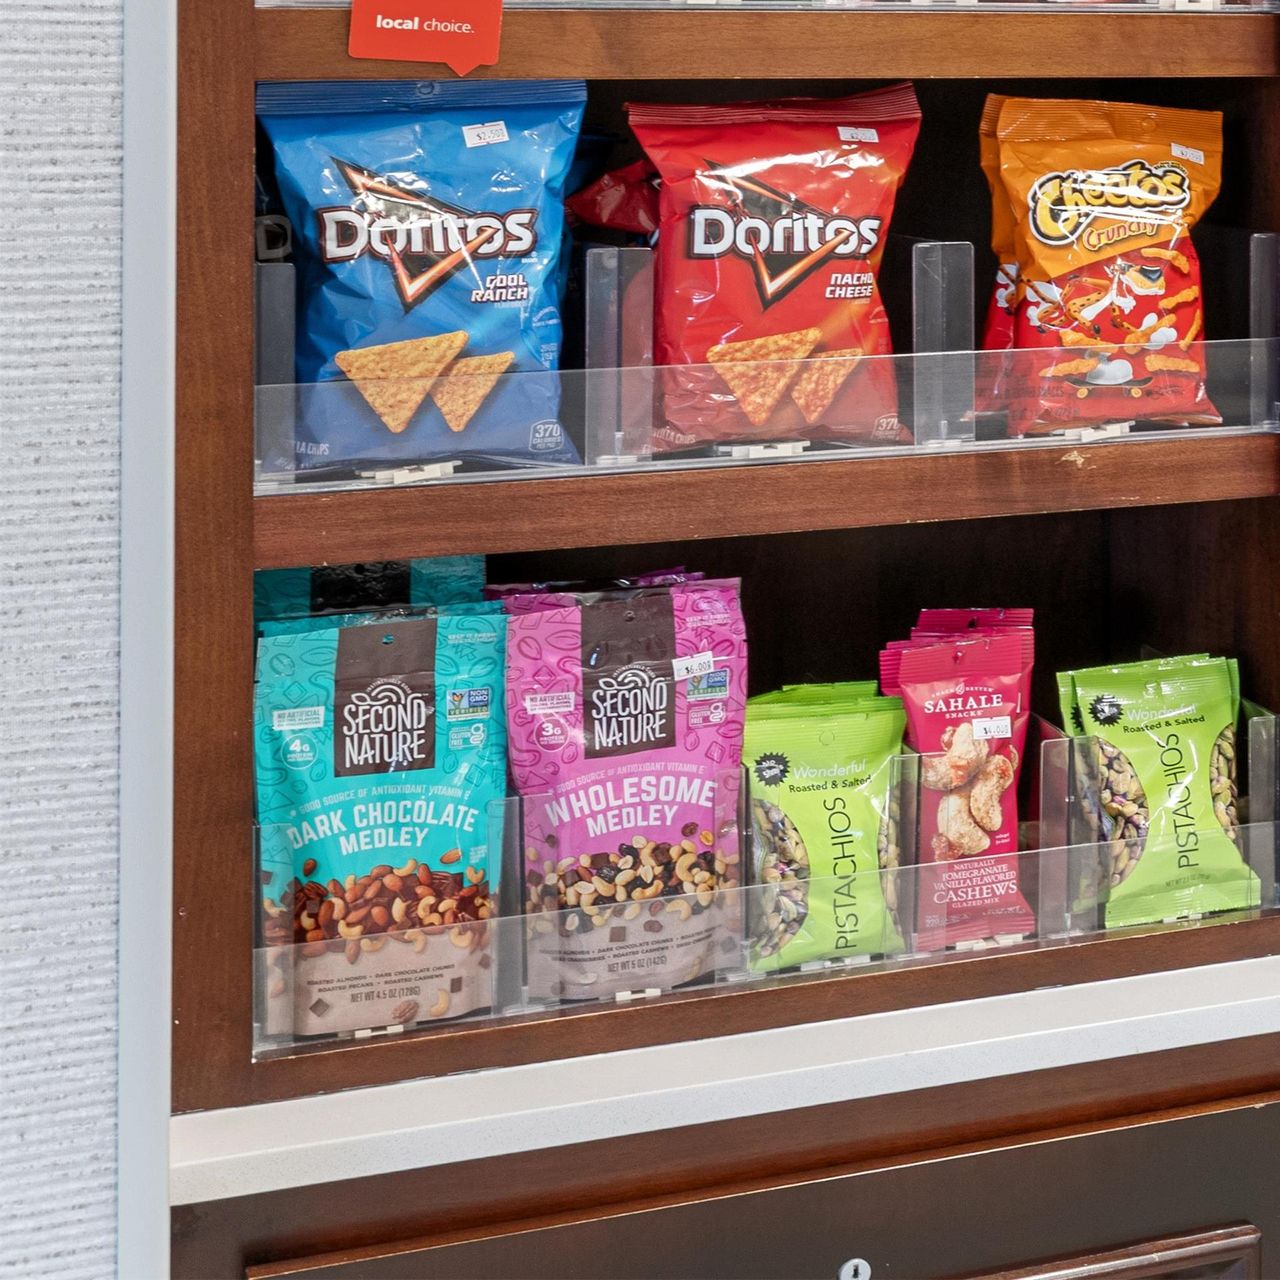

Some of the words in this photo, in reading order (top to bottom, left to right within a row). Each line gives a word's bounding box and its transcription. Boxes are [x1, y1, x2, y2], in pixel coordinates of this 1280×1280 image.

[375, 15, 419, 31] local
[423, 17, 474, 34] choice.
[1031, 161, 1190, 243] Cheetos
[320, 208, 536, 262] Doritos
[692, 209, 881, 256] Doritos
[1083, 220, 1157, 251] Crunchy
[471, 287, 528, 303] RANCH
[825, 285, 872, 299] CHEESE
[830, 273, 873, 286] NACHO
[343, 694, 427, 736] SECOND
[924, 693, 1003, 714] SAHALE
[344, 731, 426, 768] NATURE
[789, 782, 829, 794] Roasted
[841, 776, 872, 789] Salted
[792, 759, 866, 780] Wonderful
[545, 777, 718, 828] WHOLESOME
[1159, 733, 1200, 869] PISTACHIOS
[287, 812, 346, 853] DARK
[354, 800, 478, 833] CHOCOLATE
[339, 827, 428, 857] MEDLEY
[823, 796, 857, 951] PISTACHIOS
[933, 880, 1018, 904] CASHEWS
